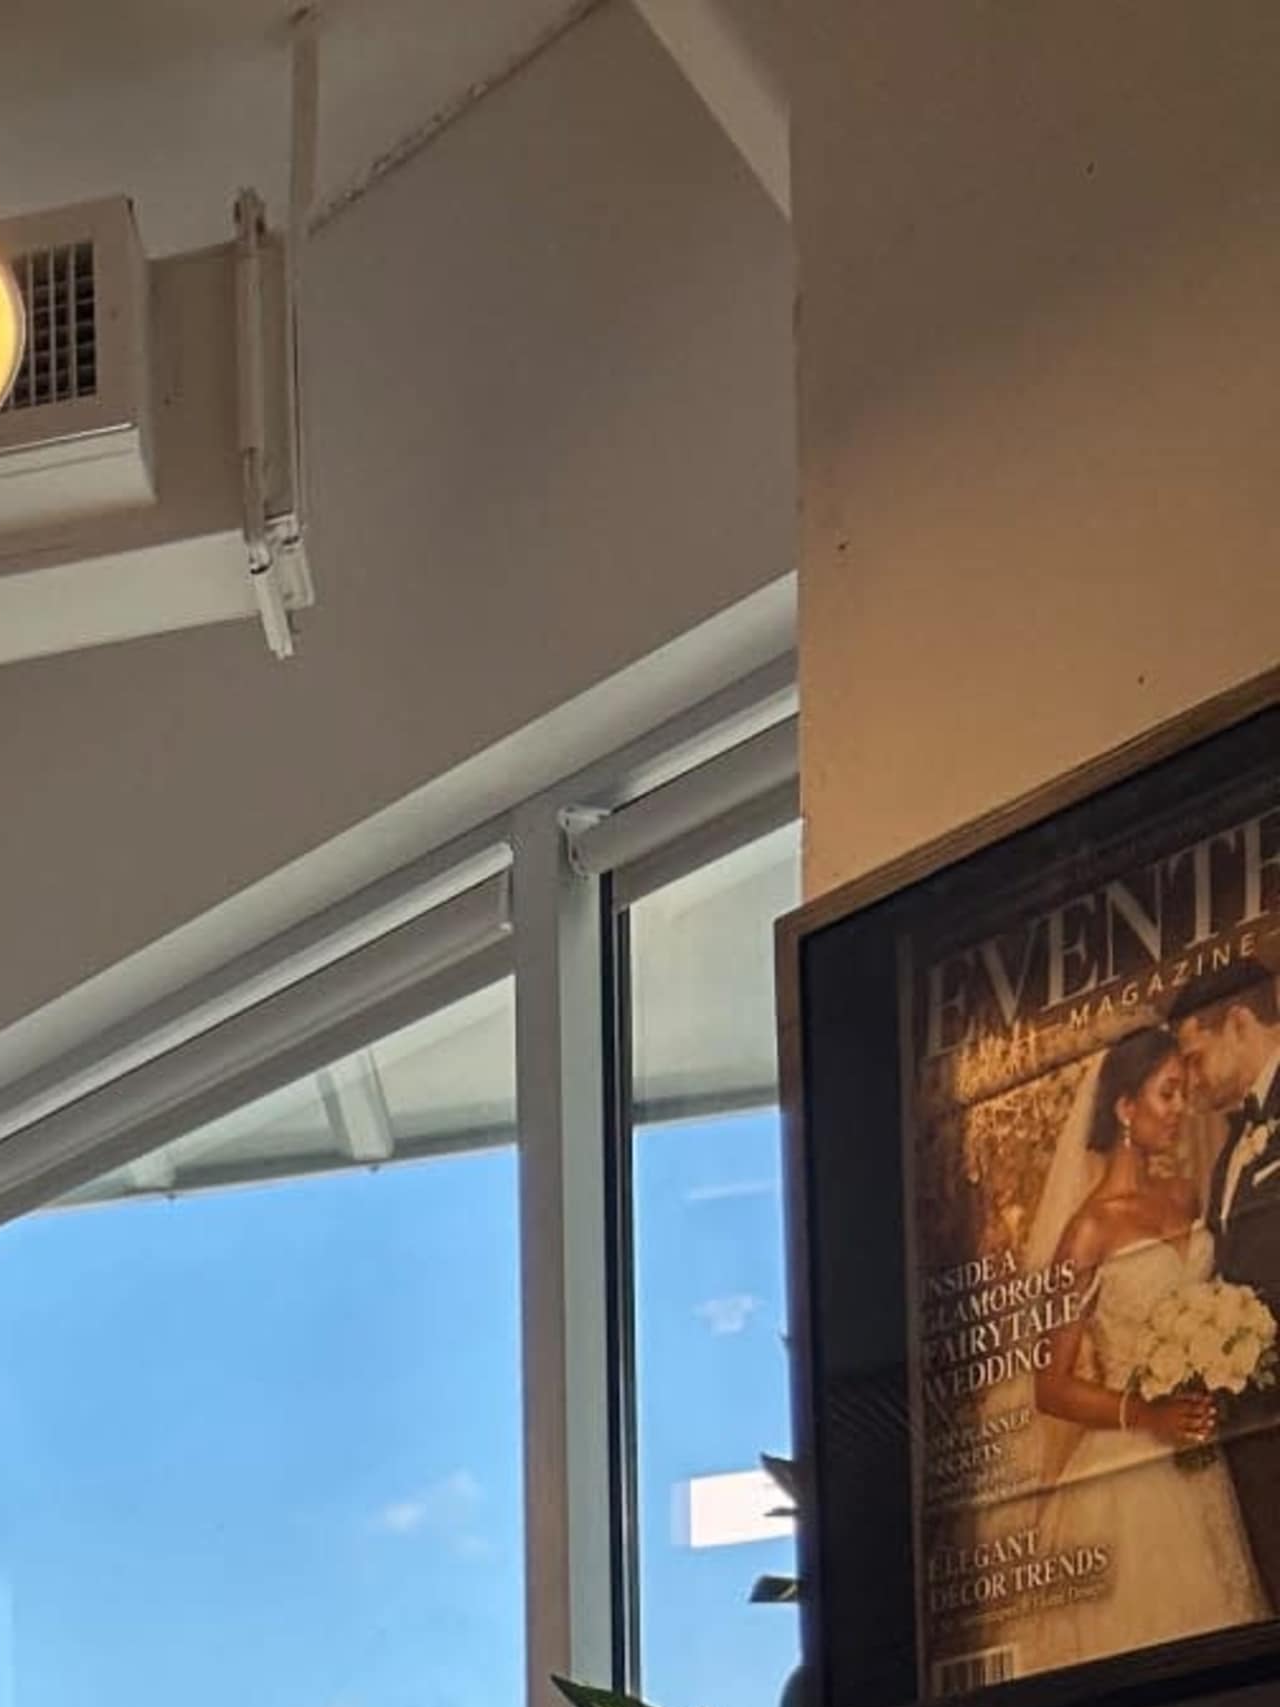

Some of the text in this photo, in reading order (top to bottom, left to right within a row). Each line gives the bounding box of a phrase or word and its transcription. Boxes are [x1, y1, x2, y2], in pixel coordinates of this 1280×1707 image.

[1070, 932, 1257, 1031] MAGAZINE
[1002, 1250, 1017, 1274] A
[924, 1291, 1081, 1368] FAIRYTALE
[924, 1338, 1052, 1402] WEDDING
[928, 1529, 1038, 1583] ELEGANT
[930, 1544, 1108, 1613] DECOR TRENDS
